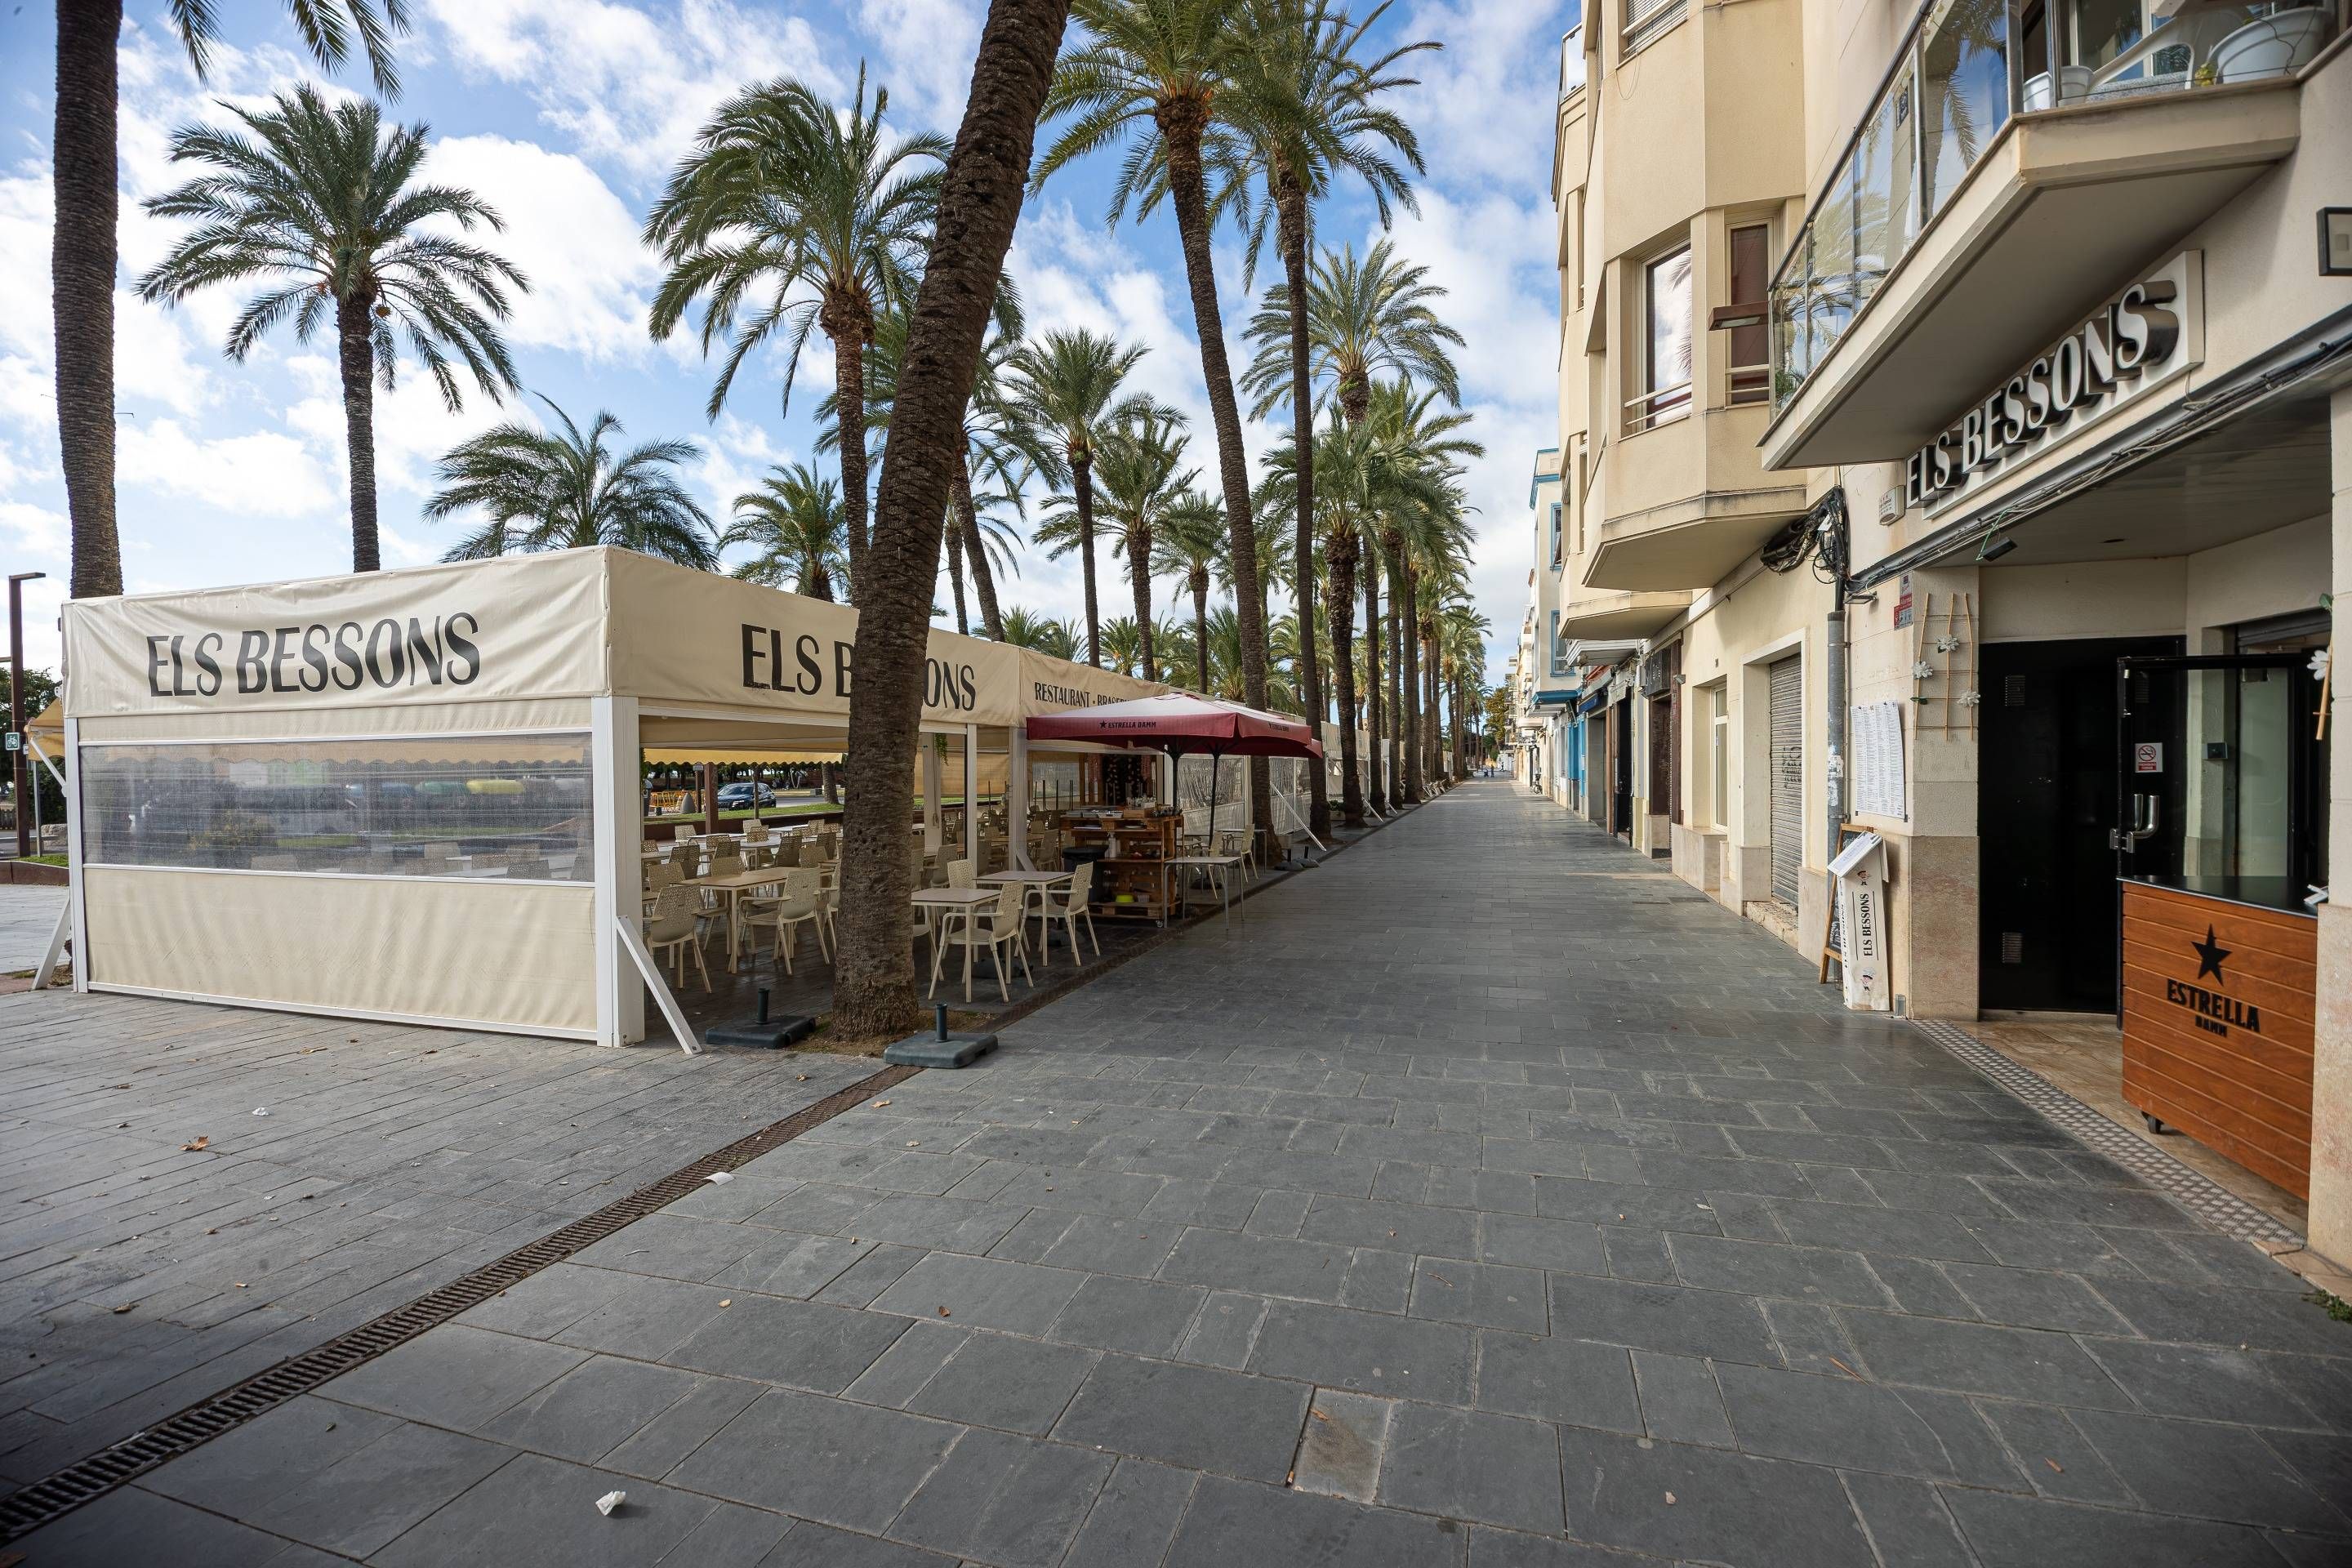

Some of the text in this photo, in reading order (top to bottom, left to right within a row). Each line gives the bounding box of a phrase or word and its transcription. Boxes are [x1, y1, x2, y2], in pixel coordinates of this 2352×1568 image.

[1906, 283, 2149, 508] ELS BESSONS
[147, 612, 480, 697] ELS BESSONS
[741, 623, 977, 711] ELS BONS
[1034, 682, 1090, 707] RESTAURANT
[1860, 893, 1873, 956] ELS BESSONS
[2167, 978, 2261, 1034] ESTRELLA
